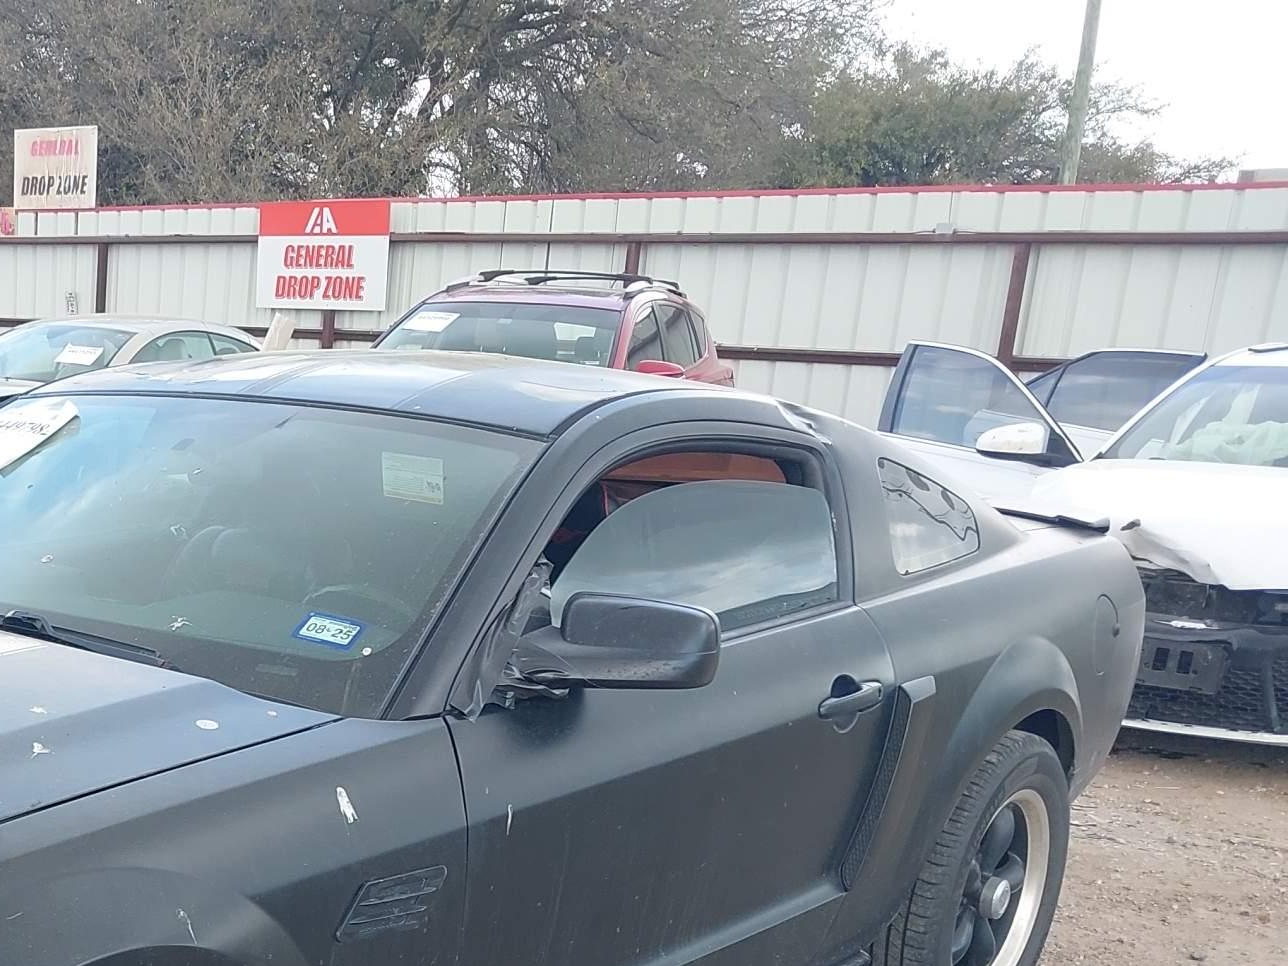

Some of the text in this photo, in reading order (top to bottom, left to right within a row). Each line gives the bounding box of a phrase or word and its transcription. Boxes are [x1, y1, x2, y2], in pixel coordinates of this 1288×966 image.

[21, 174, 88, 196] DROP ZONE
[283, 244, 354, 270] GENERAL
[275, 275, 366, 301] DROP ZONE
[331, 628, 352, 640] 25
